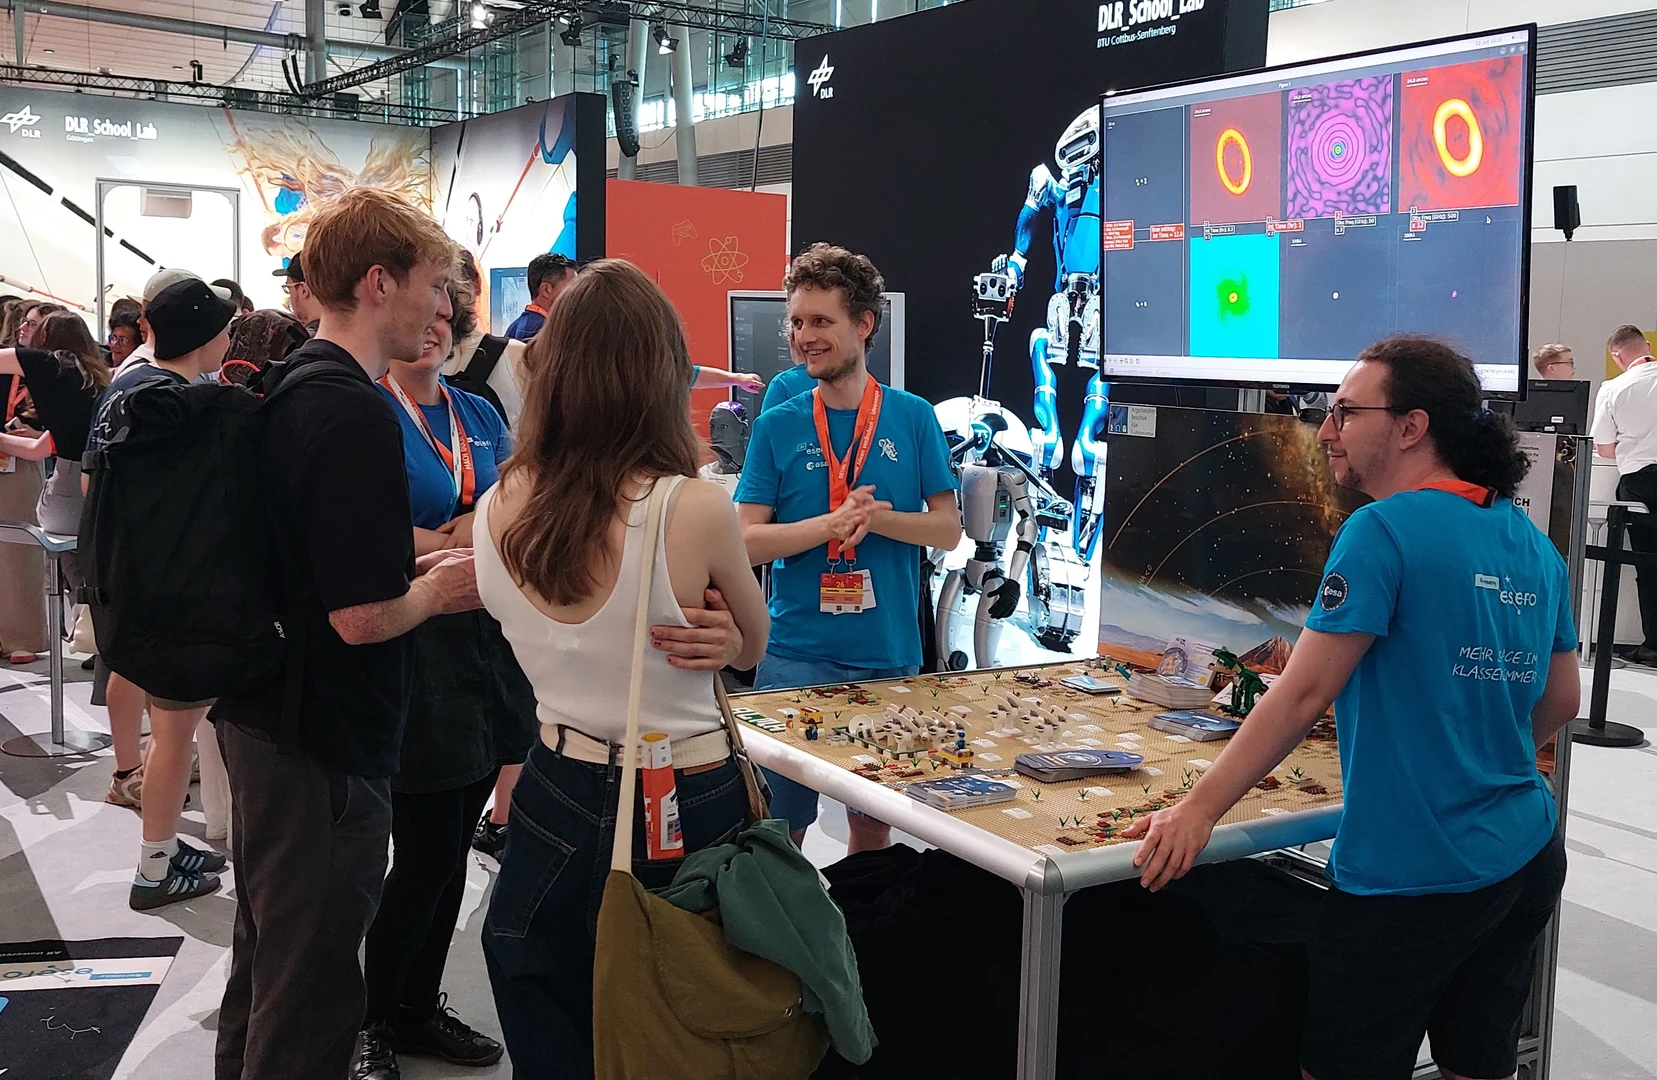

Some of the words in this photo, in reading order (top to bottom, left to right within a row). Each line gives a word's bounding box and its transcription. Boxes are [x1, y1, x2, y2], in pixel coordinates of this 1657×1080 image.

[1097, 38, 1110, 48] BTU
[1111, 24, 1177, 45] Cottbus-Senftenberg
[820, 87, 834, 99] DLR
[21, 128, 42, 138] DLR
[65, 115, 158, 140] DLR_School_Lab
[1514, 497, 1530, 507] CH
[1500, 590, 1537, 607] esero
[1459, 647, 1493, 662] MEHR
